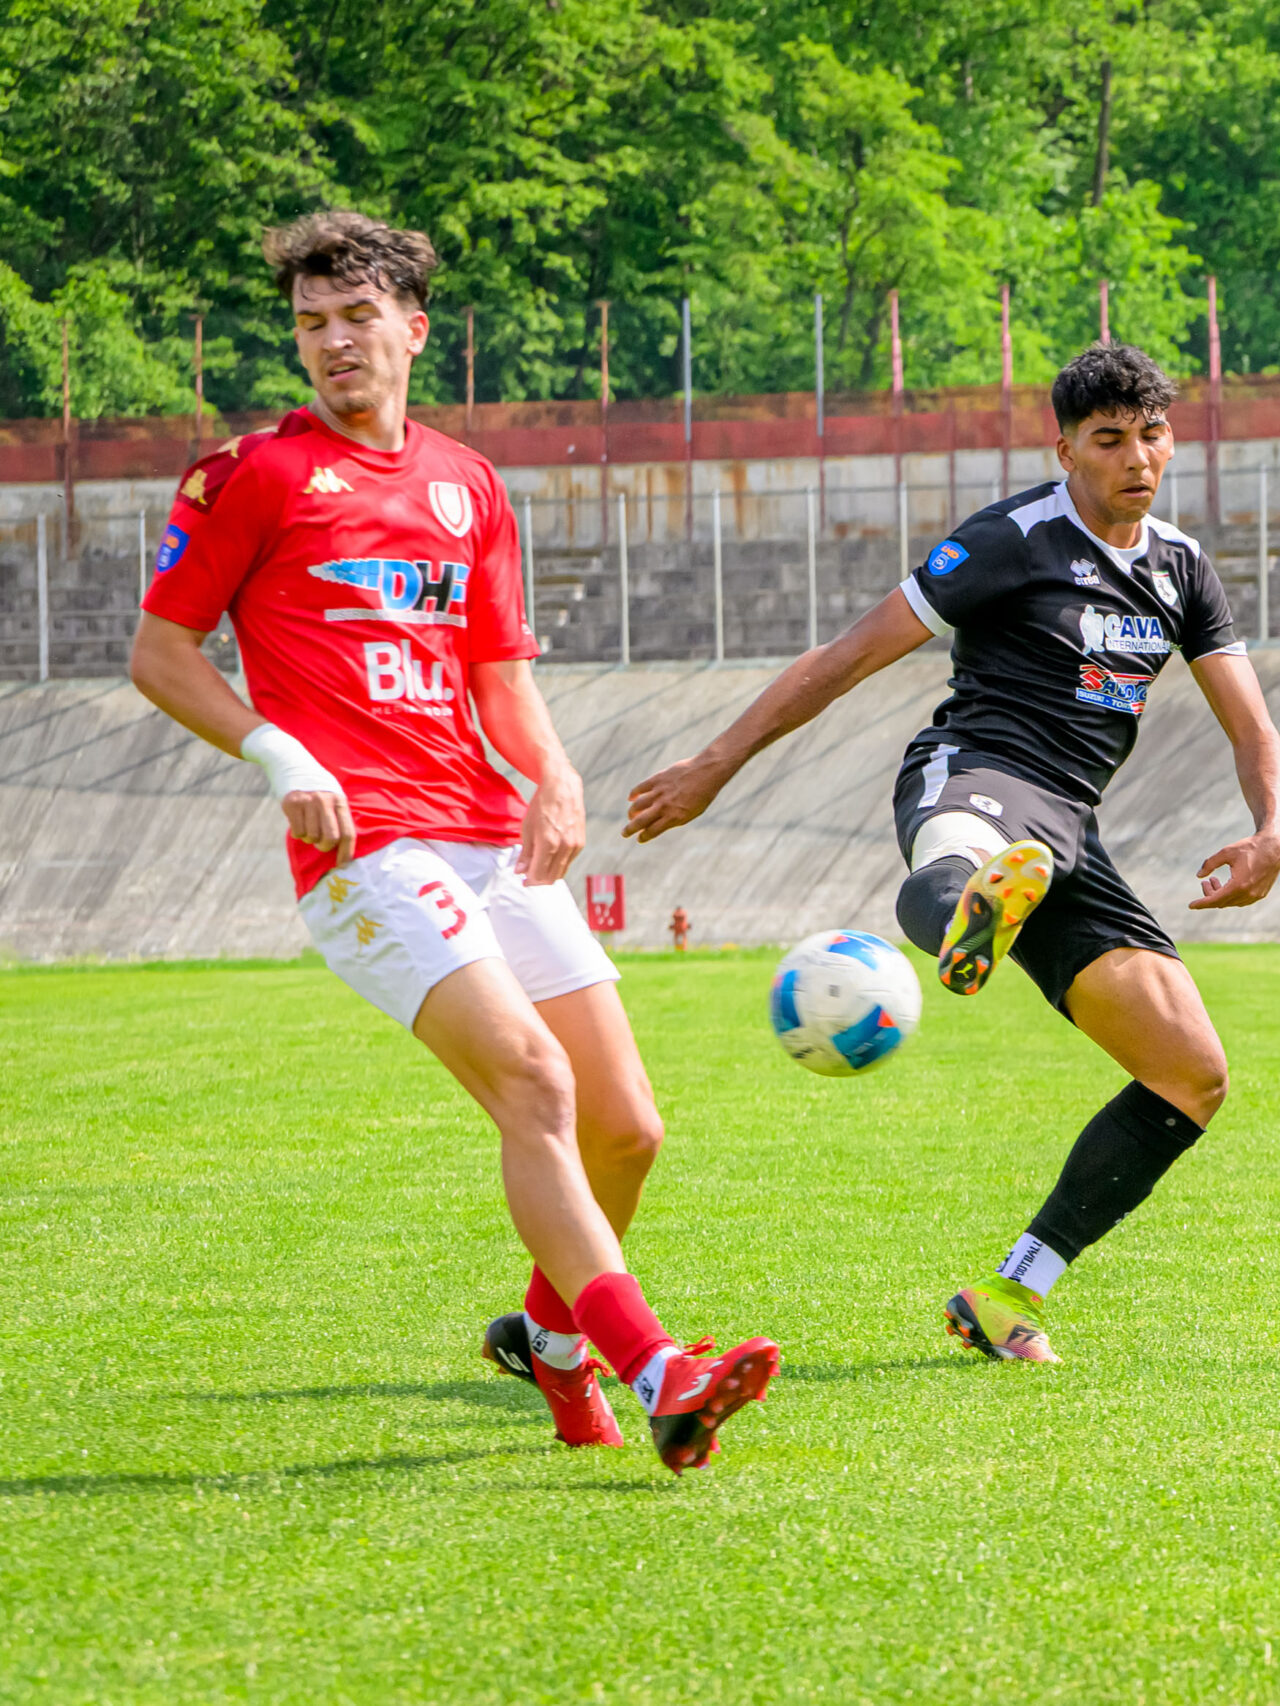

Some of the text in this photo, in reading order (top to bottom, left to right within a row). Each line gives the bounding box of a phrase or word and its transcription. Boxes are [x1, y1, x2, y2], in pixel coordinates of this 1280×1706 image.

[1104, 613, 1164, 641] CAVA
[417, 880, 467, 940] 3
[1010, 1240, 1043, 1280] FOOTBALL
